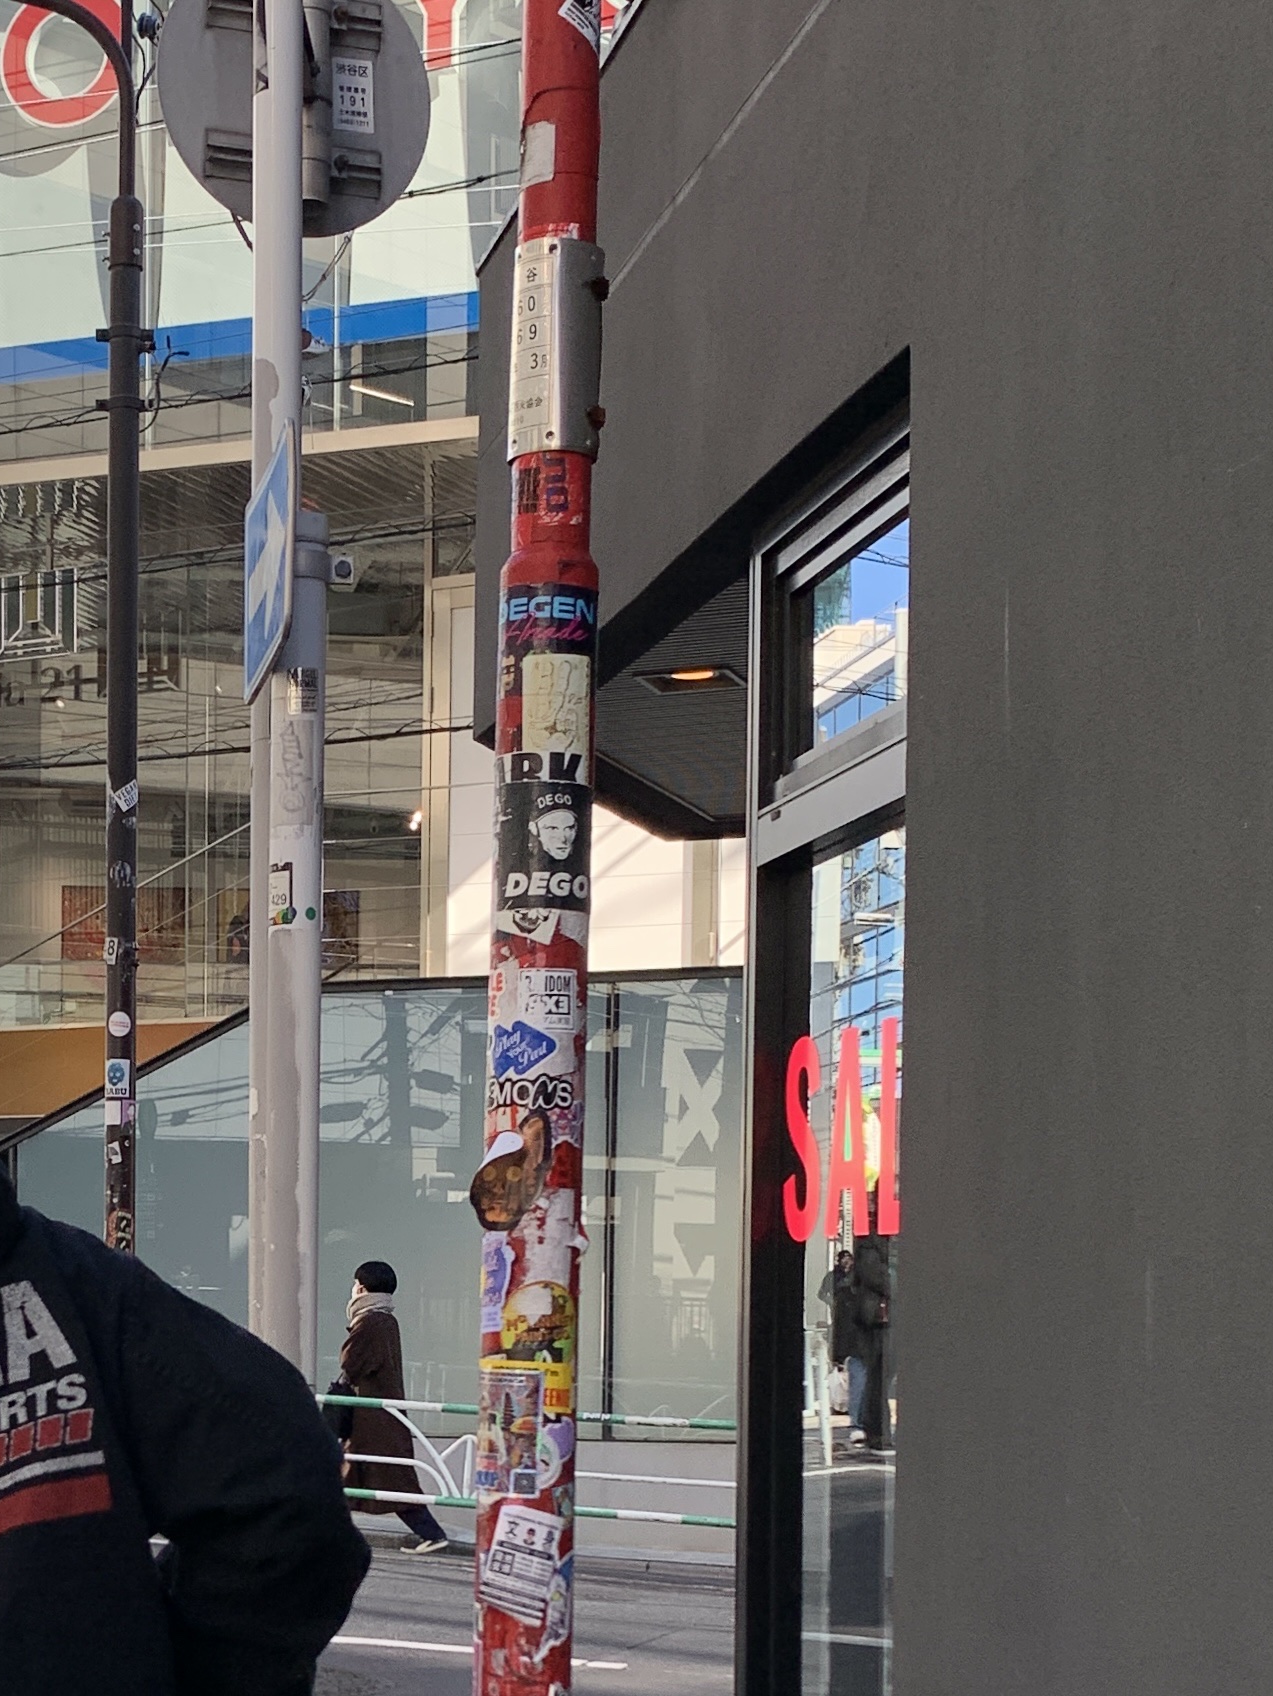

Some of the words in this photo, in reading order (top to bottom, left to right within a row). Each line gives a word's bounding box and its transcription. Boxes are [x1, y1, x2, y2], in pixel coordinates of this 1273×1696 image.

[340, 94, 365, 108] 191
[537, 793, 572, 808] DEGO
[505, 871, 588, 898] DEGO
